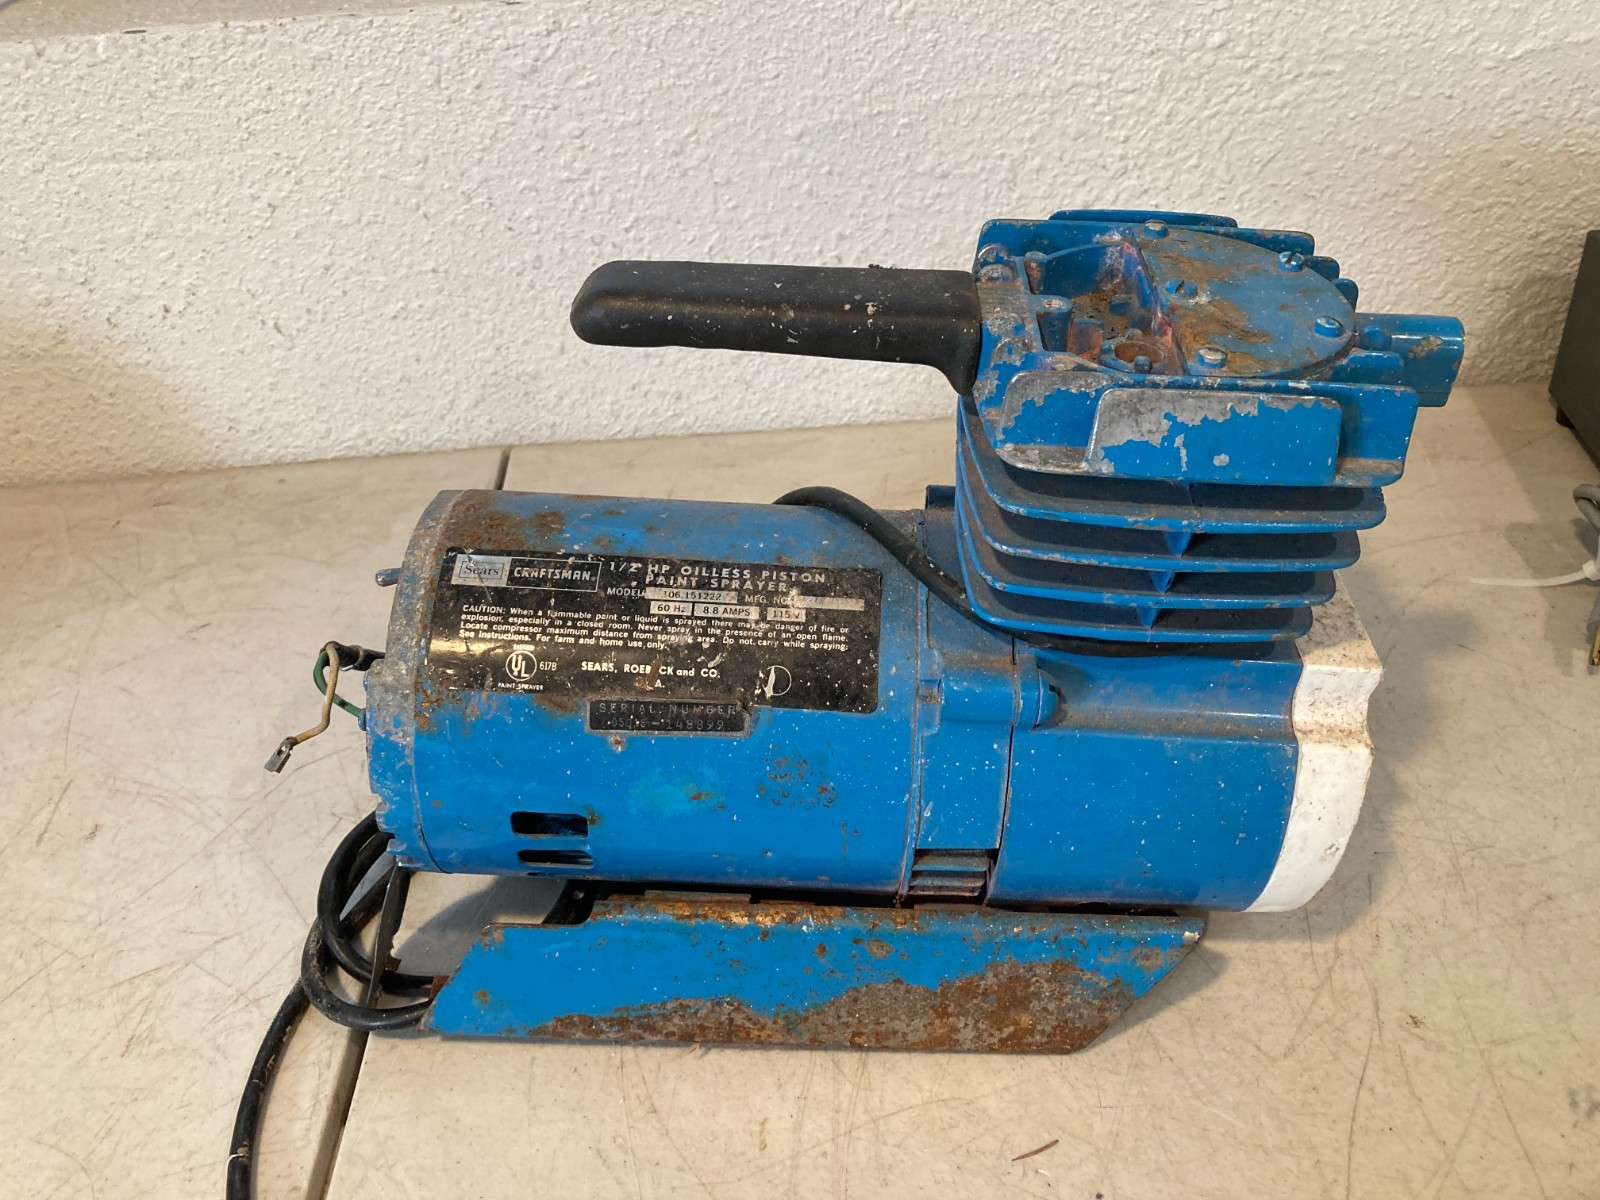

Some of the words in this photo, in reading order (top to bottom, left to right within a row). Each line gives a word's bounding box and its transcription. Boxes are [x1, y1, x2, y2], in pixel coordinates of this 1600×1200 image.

[464, 563, 499, 576] Sears
[514, 567, 591, 581] CRAFTSMAN
[610, 561, 641, 572] 1/2
[648, 563, 670, 574] HP
[681, 565, 751, 579] OILLESS
[762, 570, 825, 583] PISTON
[646, 574, 698, 587] PAINT
[710, 578, 787, 592] SPRAYER
[657, 604, 670, 613] 60
[674, 605, 686, 613] Hz
[703, 606, 719, 615] 8.8
[722, 607, 751, 616] AMPS
[773, 610, 791, 619] 115
[463, 605, 506, 614] CAUTION:
[510, 607, 533, 616] When
[596, 613, 617, 621] paint
[635, 614, 658, 623] liquid
[674, 618, 707, 627] sprayed
[711, 619, 734, 627] there
[775, 622, 804, 632] danger
[821, 625, 835, 633] fire
[460, 621, 489, 630] Locate
[492, 624, 543, 633] compressor
[546, 627, 589, 636] maximum
[592, 629, 629, 638] distance
[632, 631, 653, 640] from
[657, 633, 693, 643] spraying
[722, 636, 735, 644] Do
[783, 640, 806, 648] while
[508, 617, 551, 626] especially
[554, 617, 563, 626] in
[577, 620, 604, 628] closed
[638, 623, 662, 632] Never
[694, 626, 703, 634] in
[707, 627, 721, 635] the
[725, 629, 763, 637] presence
[796, 633, 818, 641] open
[822, 633, 849, 642] flame.
[459, 629, 475, 638] See
[479, 630, 531, 641] instructions.
[536, 633, 551, 642] For
[554, 635, 575, 644] farm
[579, 637, 595, 645] and
[599, 637, 623, 647] home
[581, 661, 618, 674] SEARS,
[676, 667, 695, 677] and
[701, 668, 721, 679] CO.
[517, 683, 544, 691] SPRAYER
[600, 702, 656, 714] SERIAL
[669, 703, 737, 716] NUMBER
